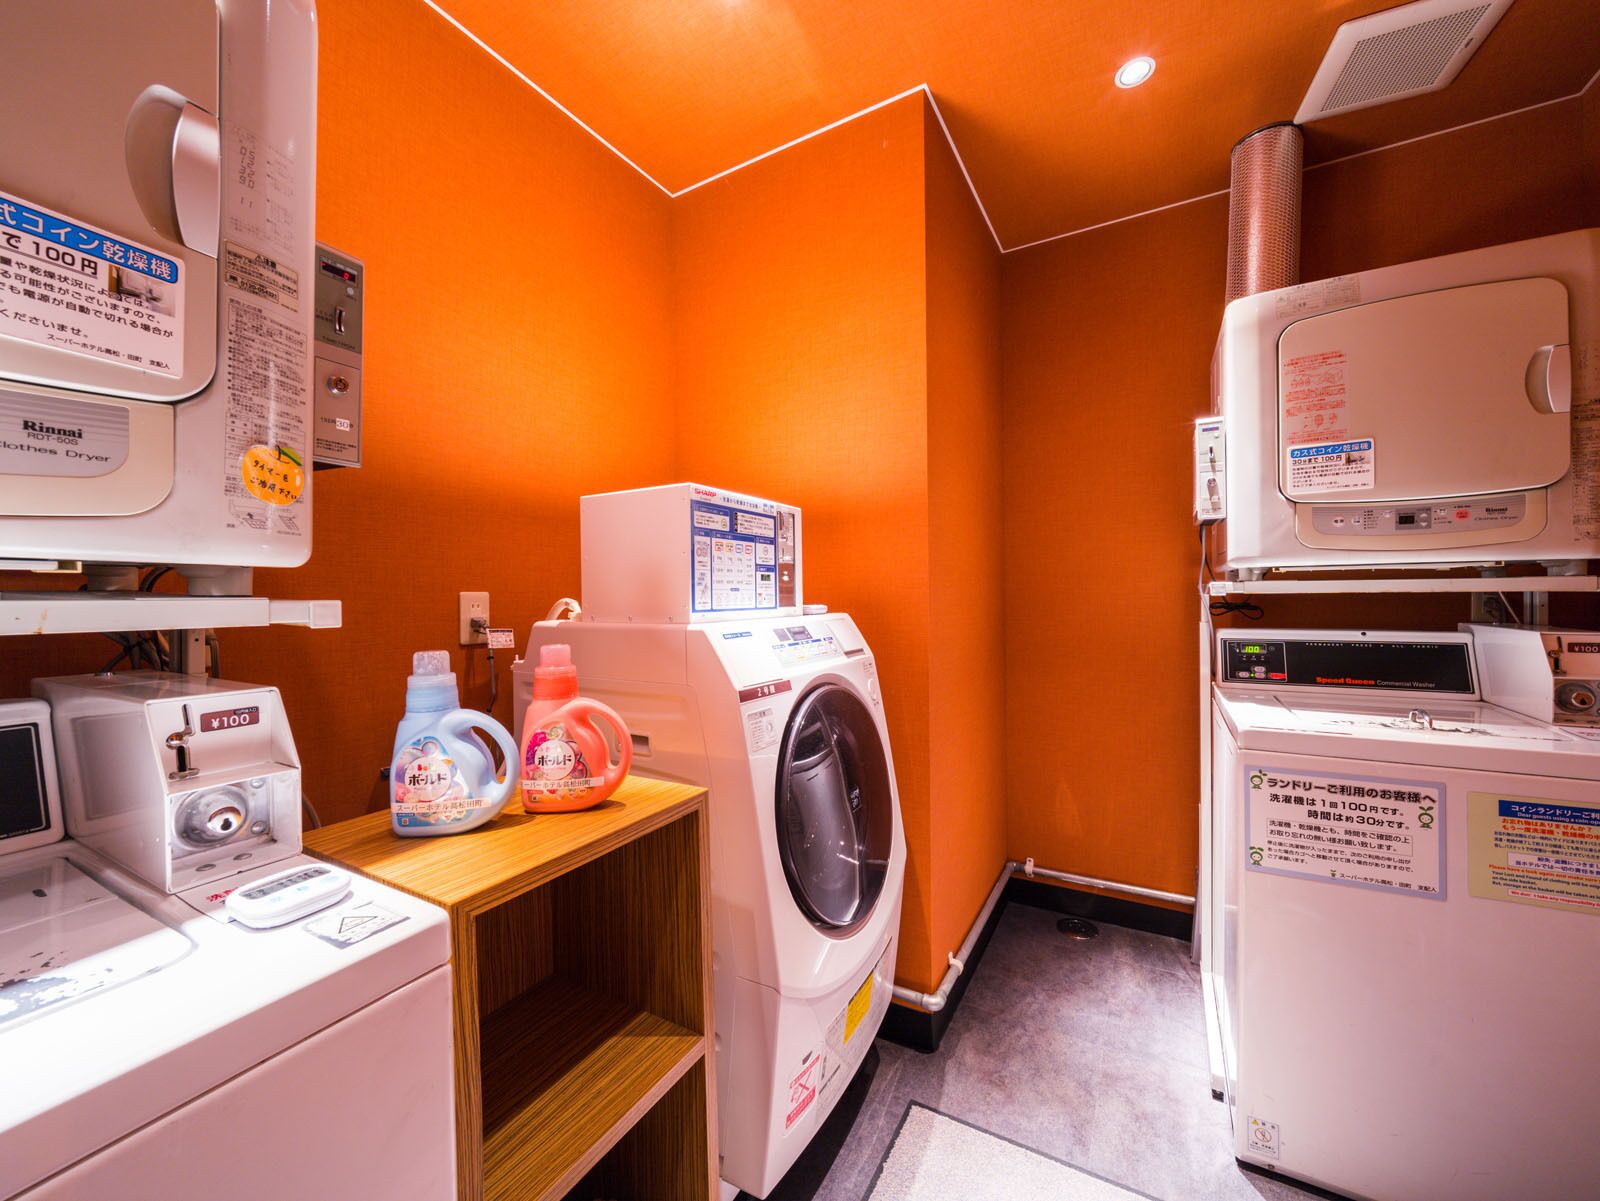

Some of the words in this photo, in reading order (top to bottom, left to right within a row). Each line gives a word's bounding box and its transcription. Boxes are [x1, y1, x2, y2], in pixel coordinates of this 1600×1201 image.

[22, 419, 83, 439] Rinnai
[336, 419, 349, 429] 30
[27, 432, 79, 446] RDT-50S
[65, 449, 112, 463] Dryer
[694, 487, 717, 498] SHARP
[1245, 645, 1260, 654] 100
[1574, 645, 1599, 653] ¥100
[1316, 676, 1344, 685] Speed
[1345, 677, 1375, 685] Queen
[211, 713, 250, 729] ¥100
[537, 753, 573, 767] ボールド
[408, 772, 448, 787] ボールド
[1266, 777, 1437, 804] ランドリーご利用のお客様へ
[1269, 792, 1405, 817] 洗濯機は1回100円です。
[1307, 809, 1410, 830] 時間は約30分です。
